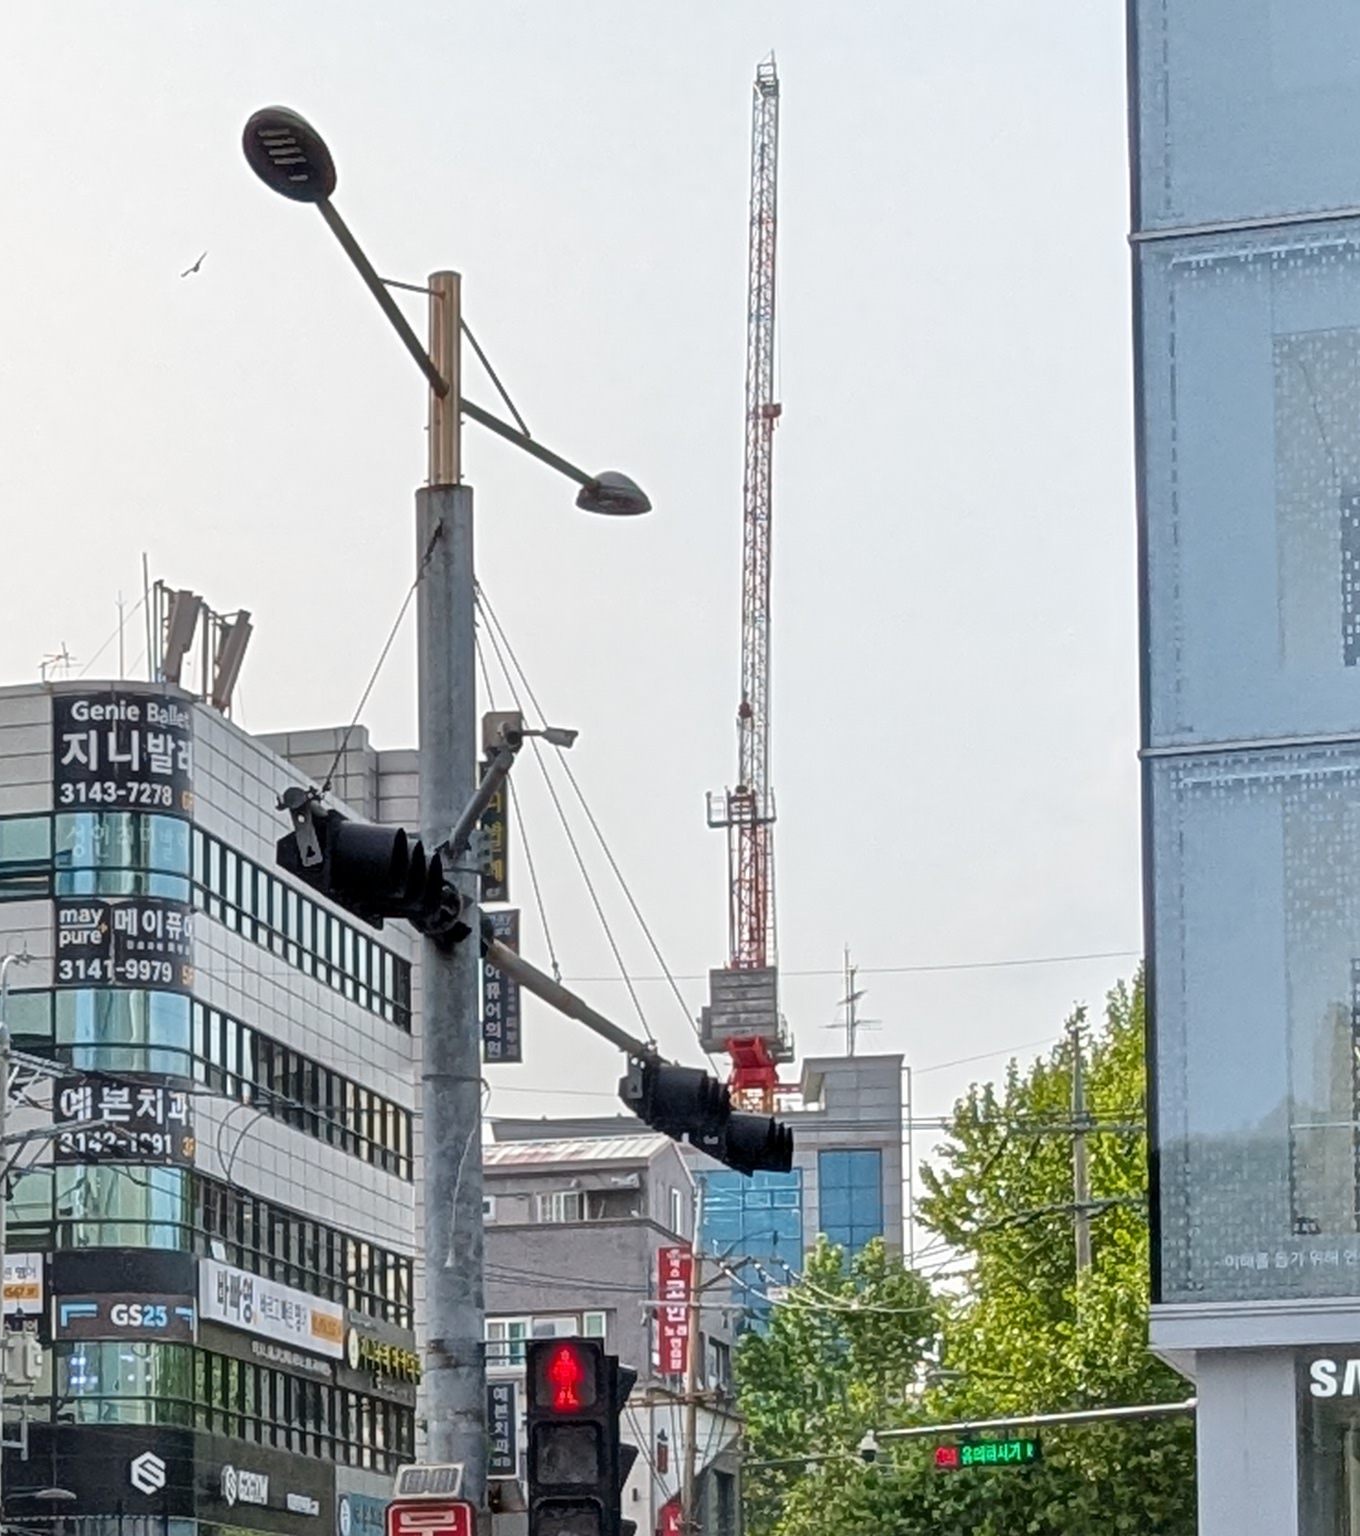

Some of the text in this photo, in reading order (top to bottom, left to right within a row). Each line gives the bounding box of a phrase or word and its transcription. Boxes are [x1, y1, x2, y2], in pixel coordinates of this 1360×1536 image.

[71, 700, 140, 721] Genie
[60, 781, 173, 806] 3143-7278
[59, 908, 103, 925] may
[59, 929, 102, 948] pure
[59, 958, 173, 983] 3141-9979
[110, 1303, 168, 1327] GS25
